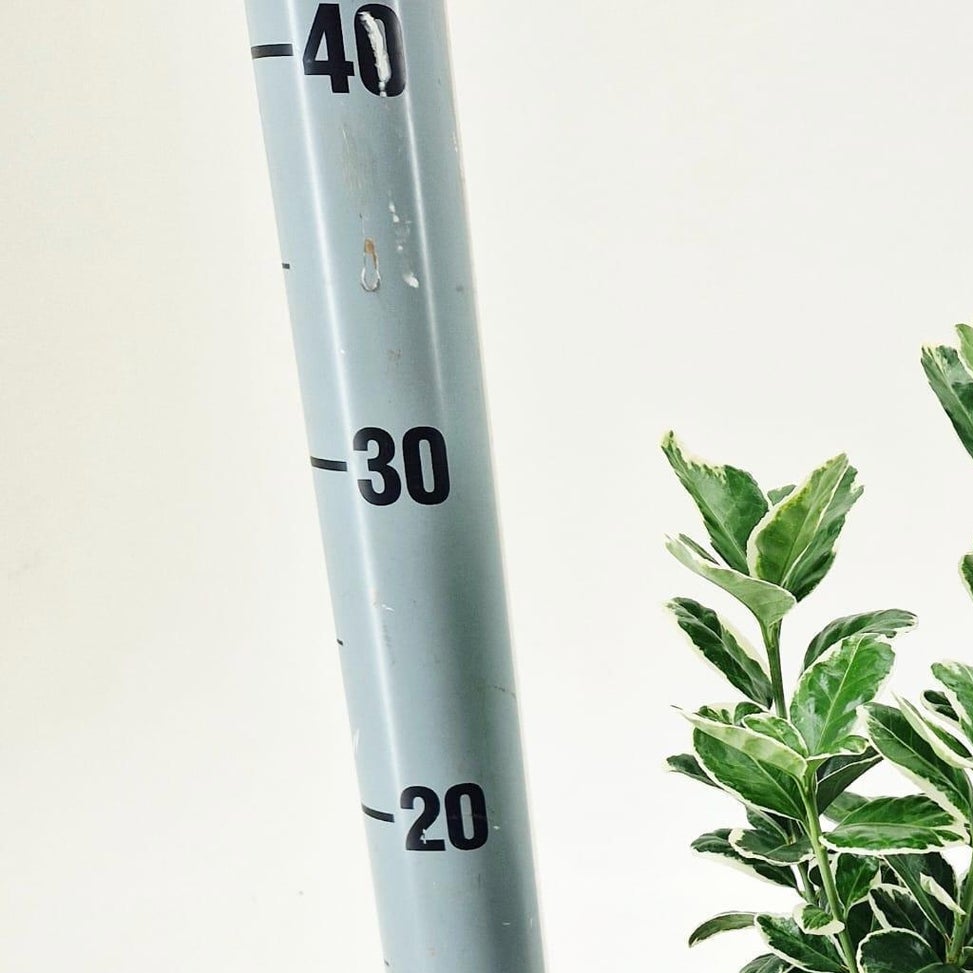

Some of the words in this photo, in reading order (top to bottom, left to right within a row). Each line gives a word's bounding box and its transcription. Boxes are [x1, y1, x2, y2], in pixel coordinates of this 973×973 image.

[303, 3, 406, 97] 40
[353, 426, 451, 506] 30
[400, 783, 488, 851] 20
